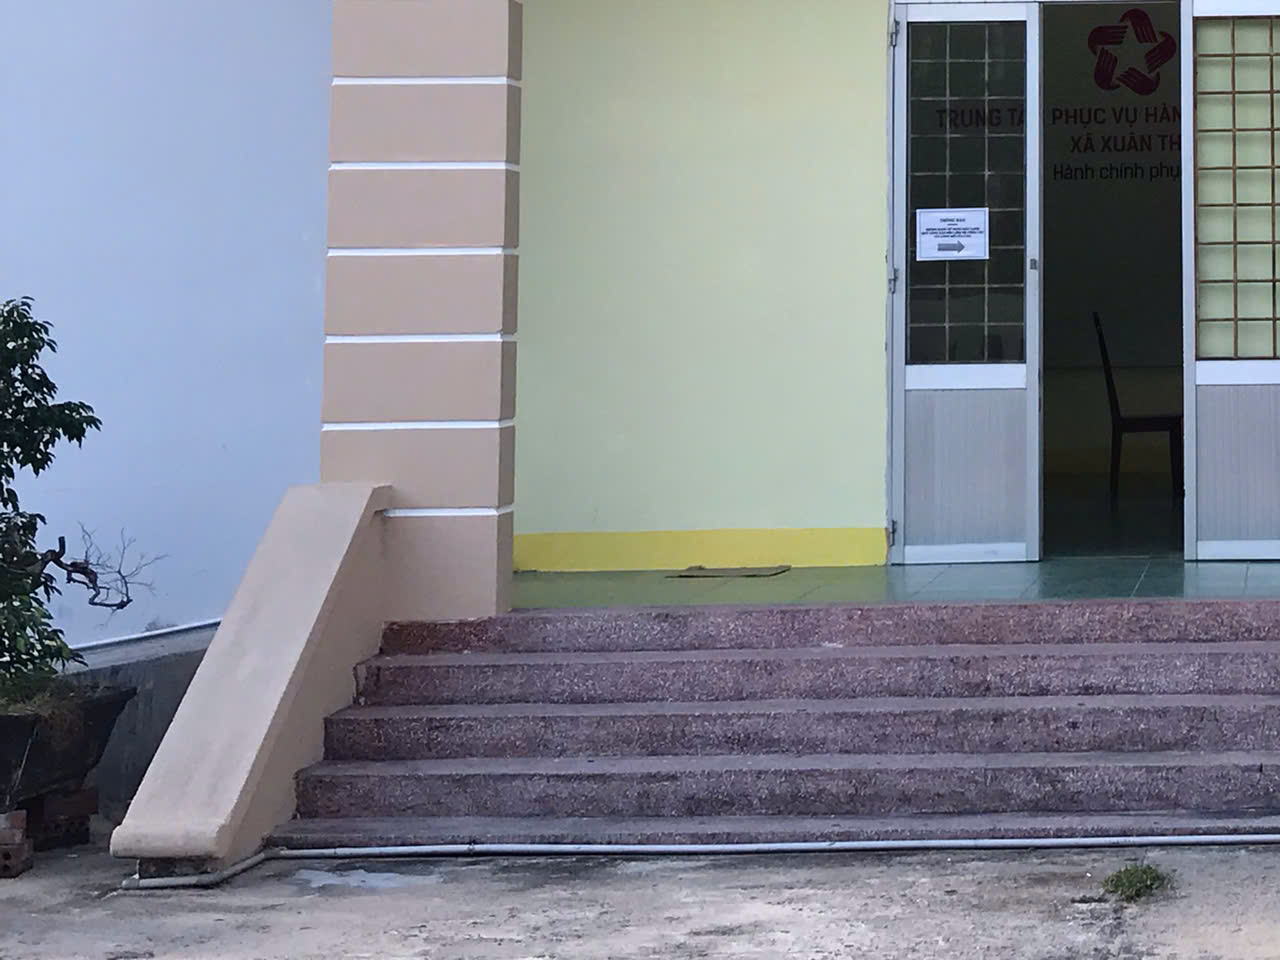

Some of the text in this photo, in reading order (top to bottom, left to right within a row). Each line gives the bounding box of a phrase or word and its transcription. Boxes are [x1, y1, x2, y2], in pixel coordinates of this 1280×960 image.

[936, 108, 1001, 129] TRUNG
[1052, 106, 1107, 129] PHỤC
[1112, 106, 1138, 128] VỤ
[1144, 103, 1180, 124] HÀN
[1071, 131, 1180, 153] XÃ XUÂN TH
[1053, 161, 1180, 182] Hành chính phụ
